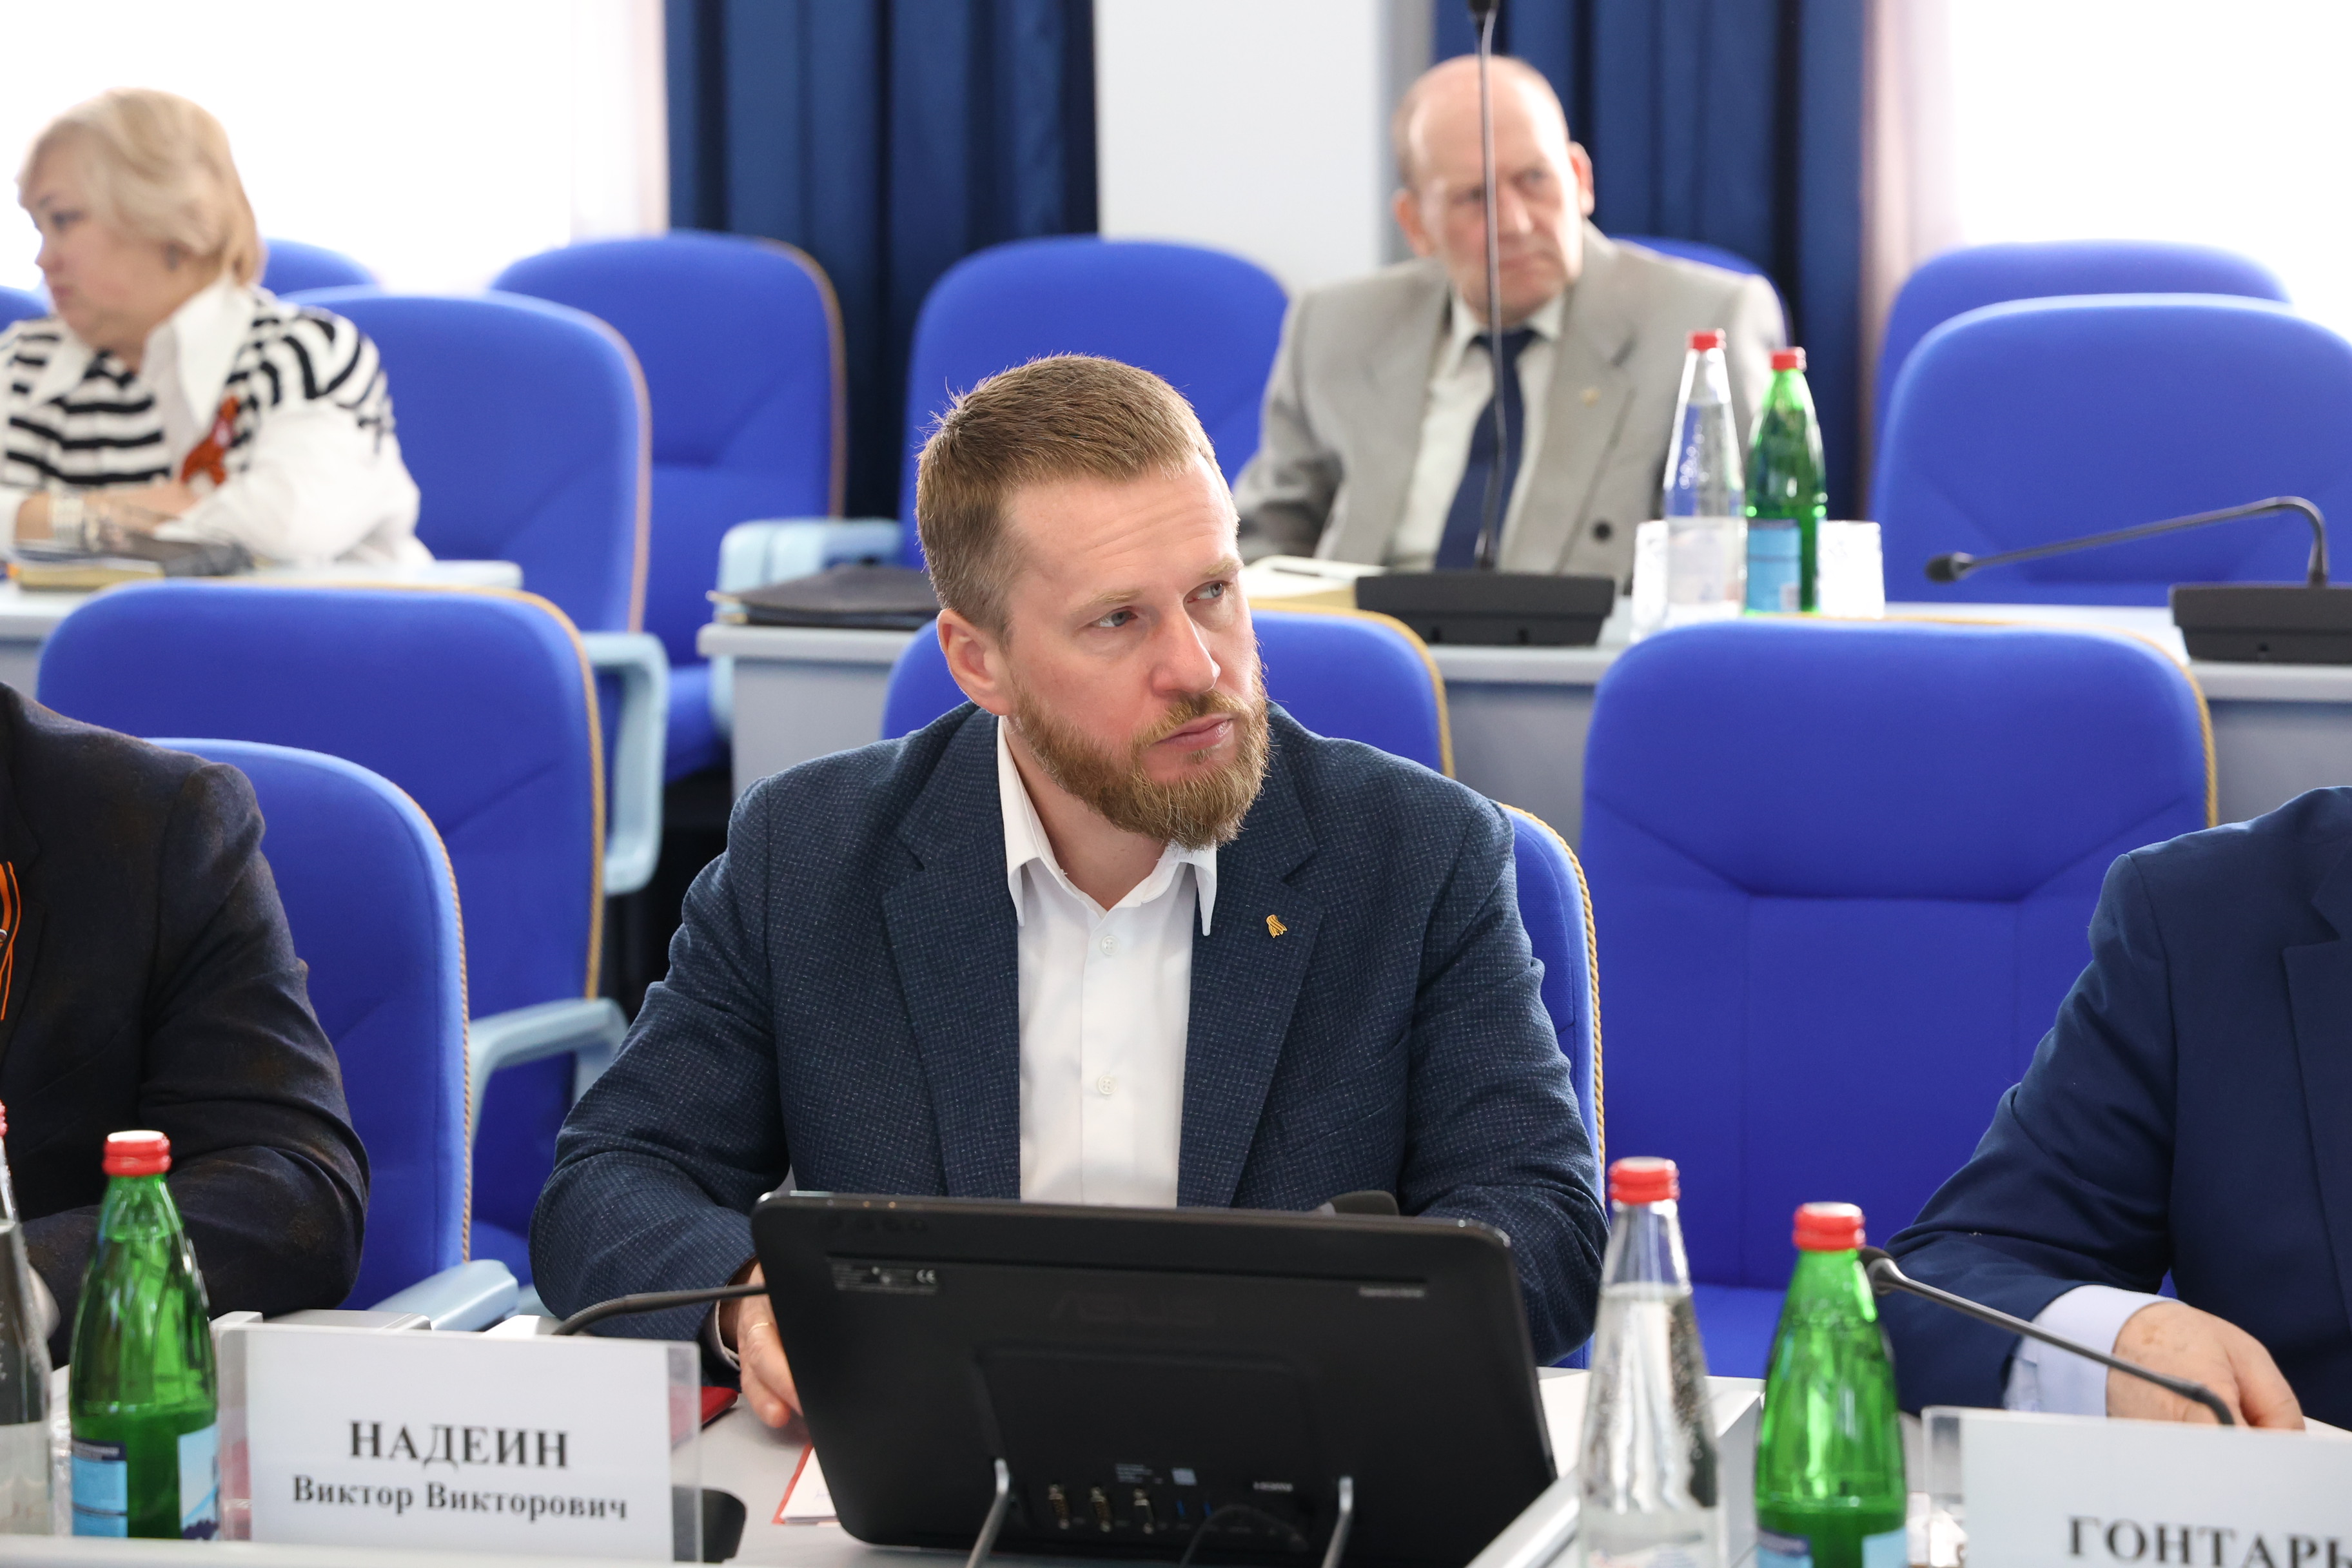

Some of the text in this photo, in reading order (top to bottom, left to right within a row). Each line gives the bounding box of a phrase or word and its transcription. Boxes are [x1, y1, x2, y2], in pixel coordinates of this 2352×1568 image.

[349, 1420, 569, 1471] НАДЕИН
[293, 1475, 628, 1522] Виктор Викторович
